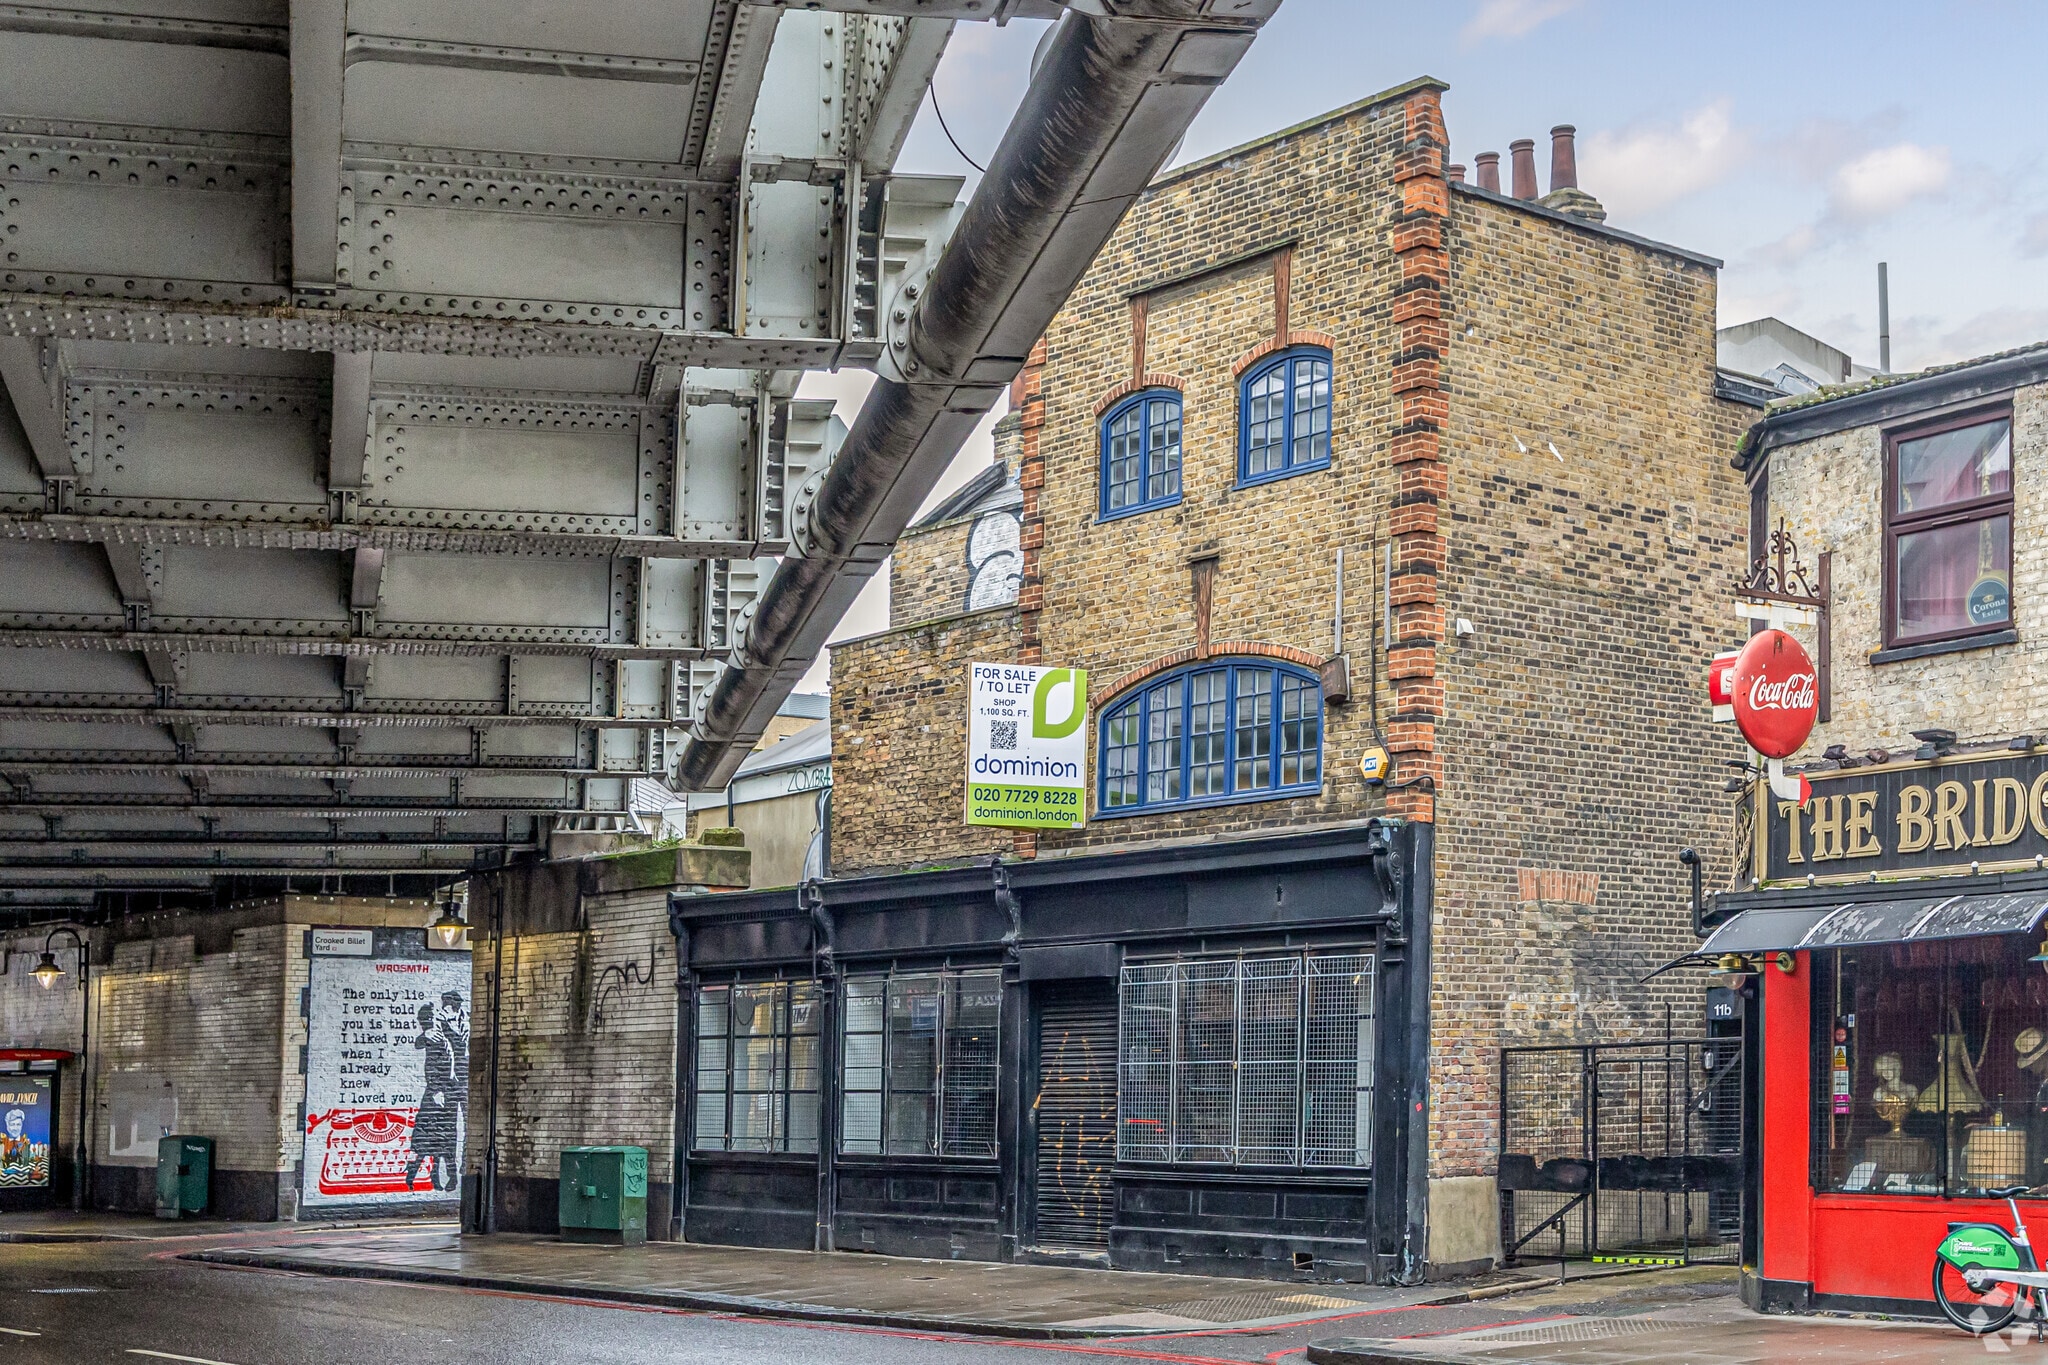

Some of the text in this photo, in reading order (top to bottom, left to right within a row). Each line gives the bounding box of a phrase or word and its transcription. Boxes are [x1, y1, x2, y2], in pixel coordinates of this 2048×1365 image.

[1973, 598, 2006, 614] Corona
[1982, 609, 2000, 618] Extra
[975, 668, 1036, 681] FOR SALE
[980, 681, 1030, 694] / TO LET
[1749, 674, 1815, 710] Coca-Cola
[981, 708, 999, 716] 1,100
[1002, 709, 1015, 717] SQ.
[975, 754, 1077, 777] dominion
[974, 788, 1076, 805] 020 7729 8228
[975, 806, 1077, 821] dominion.london
[1778, 790, 1882, 864] THE
[343, 988, 424, 1002] The only lie
[343, 1004, 415, 1015] I ever told
[1714, 1004, 1731, 1016] 11b
[342, 1018, 416, 1031] you is that
[341, 1033, 415, 1046] I liked you
[341, 1048, 384, 1059] when I
[341, 1063, 391, 1076] already
[340, 1078, 370, 1089] knew
[339, 1092, 417, 1106] I loved you.
